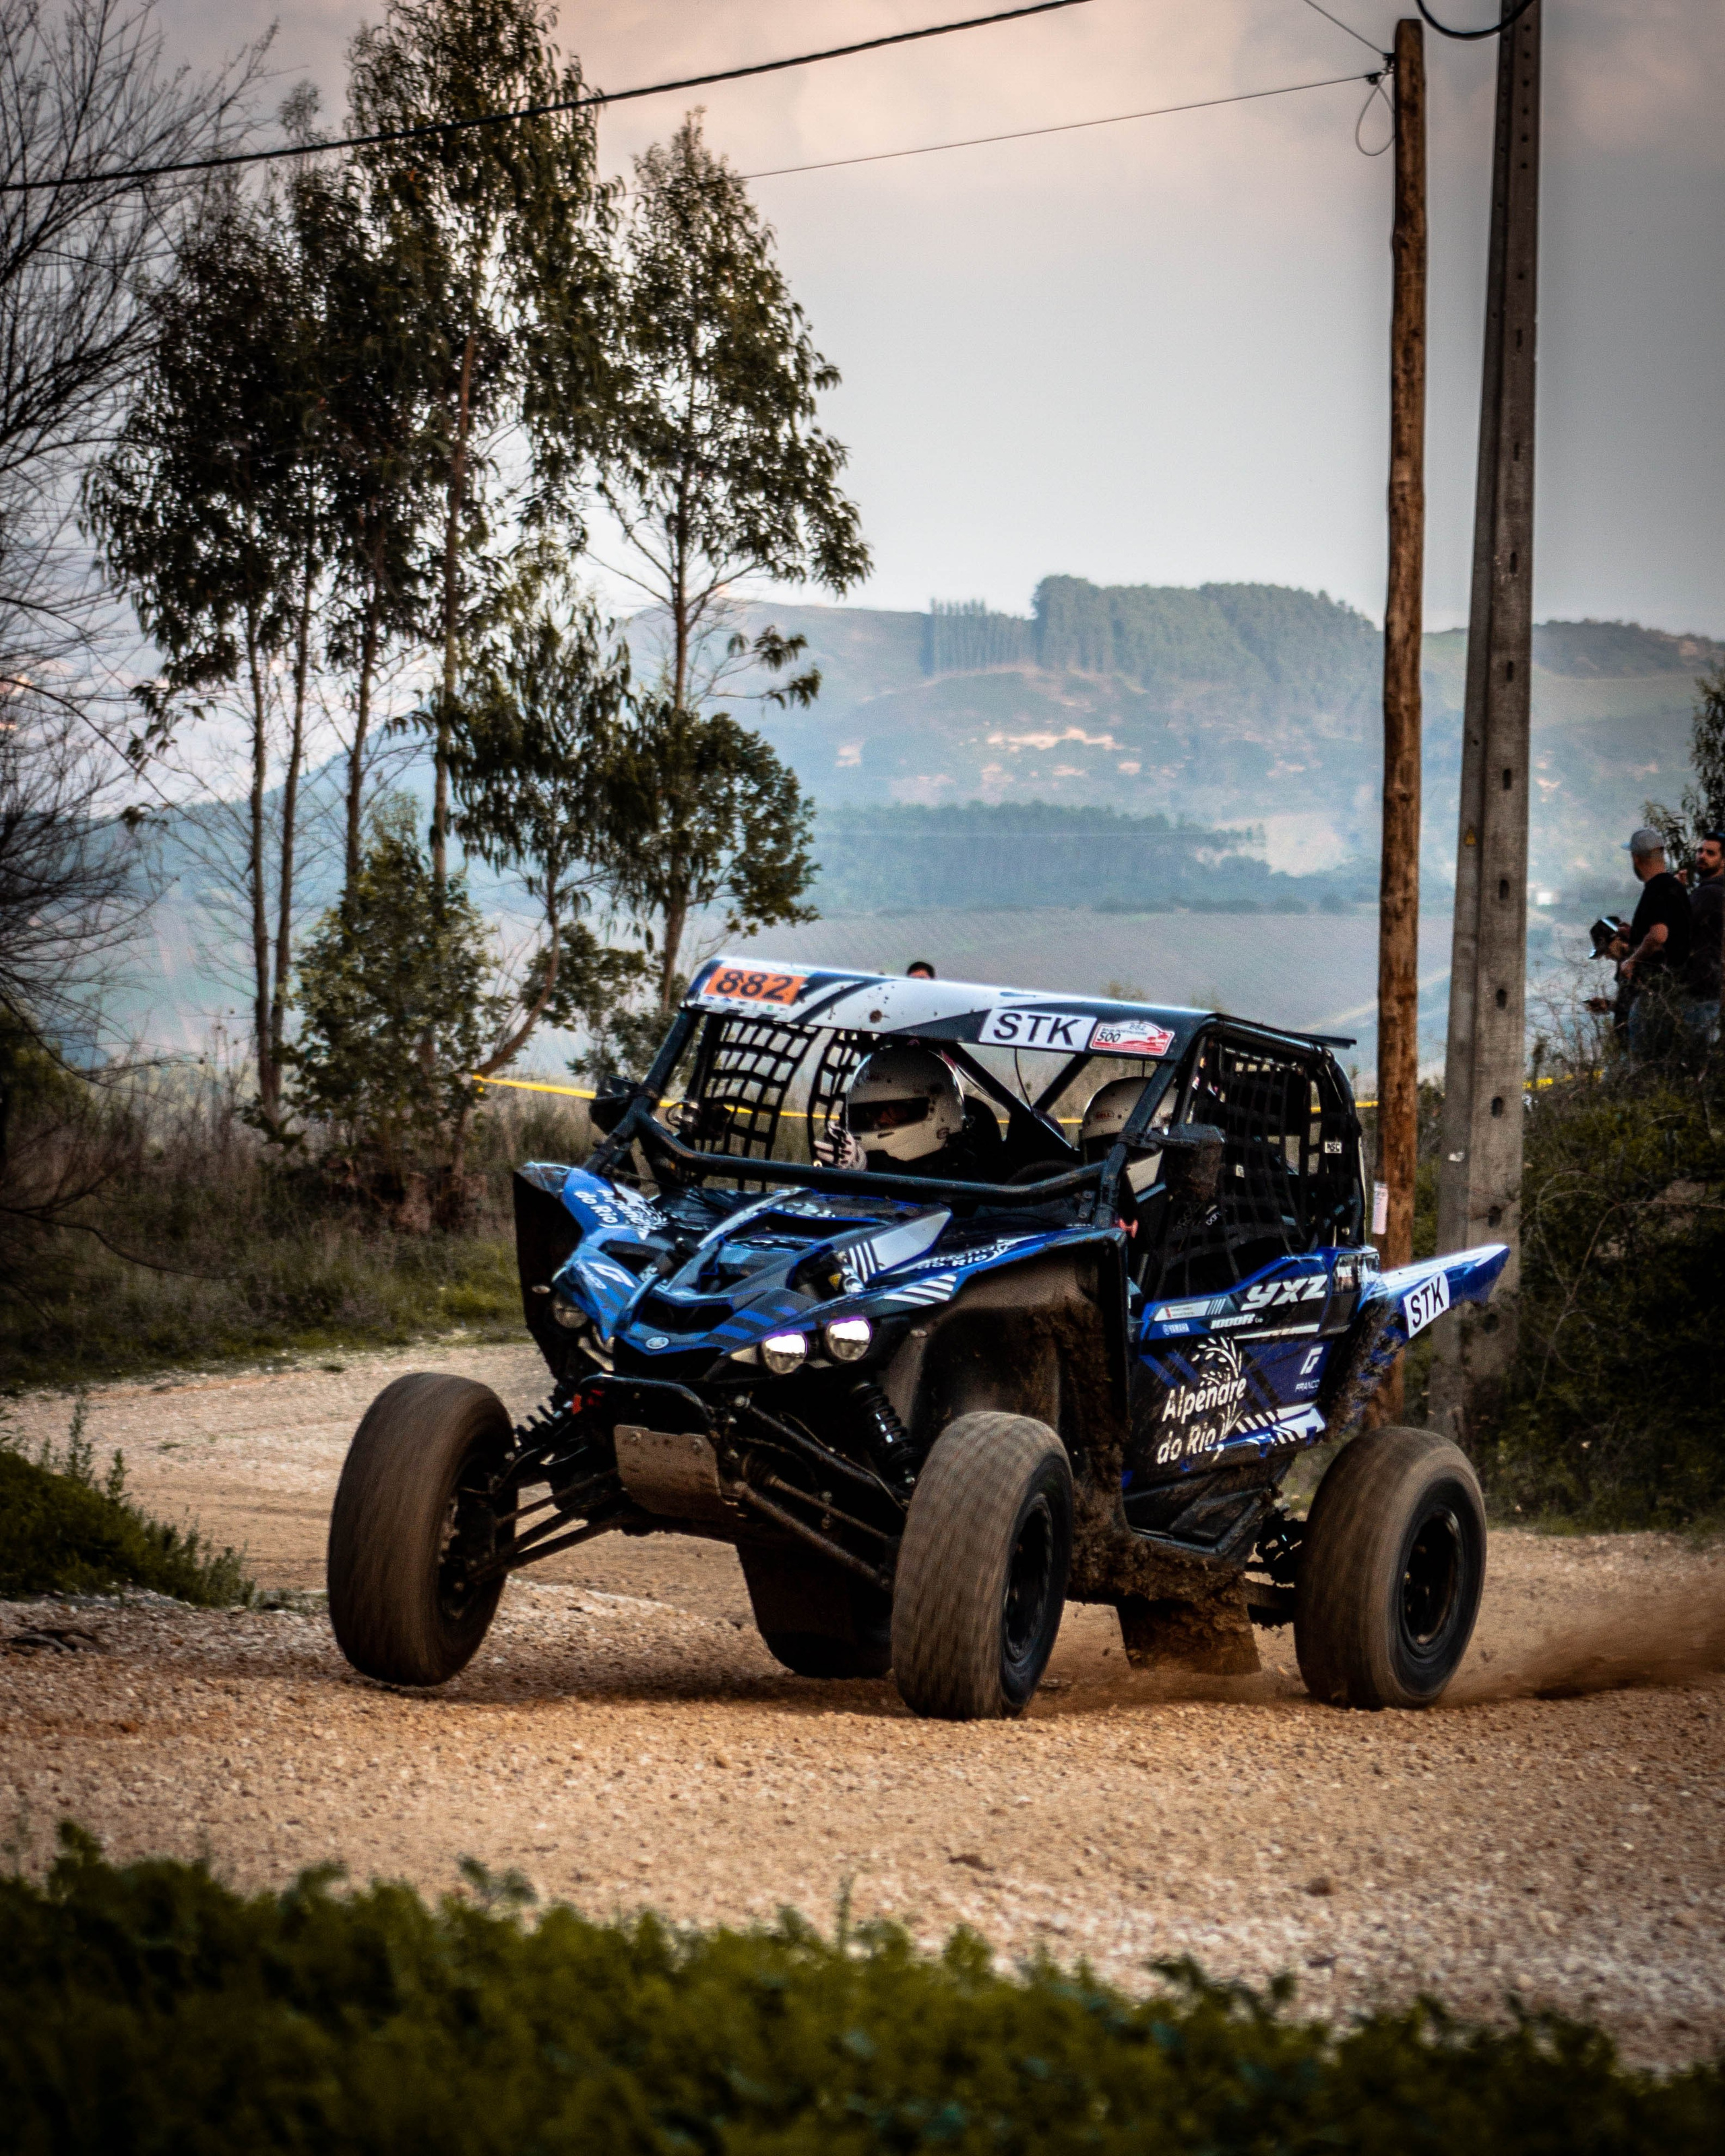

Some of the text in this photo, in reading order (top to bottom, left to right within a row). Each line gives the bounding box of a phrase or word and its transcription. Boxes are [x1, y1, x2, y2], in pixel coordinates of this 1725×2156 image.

[716, 970, 793, 1001] 882
[993, 1013, 1081, 1046] STK
[1097, 1031, 1121, 1042] 500
[574, 1191, 618, 1224] do Rio
[952, 1254, 988, 1267] Rio
[1410, 1276, 1444, 1329] STK
[1210, 1314, 1255, 1329] 1000R
[1162, 1378, 1247, 1424] Alpendre
[1157, 1422, 1216, 1464] do Rio
